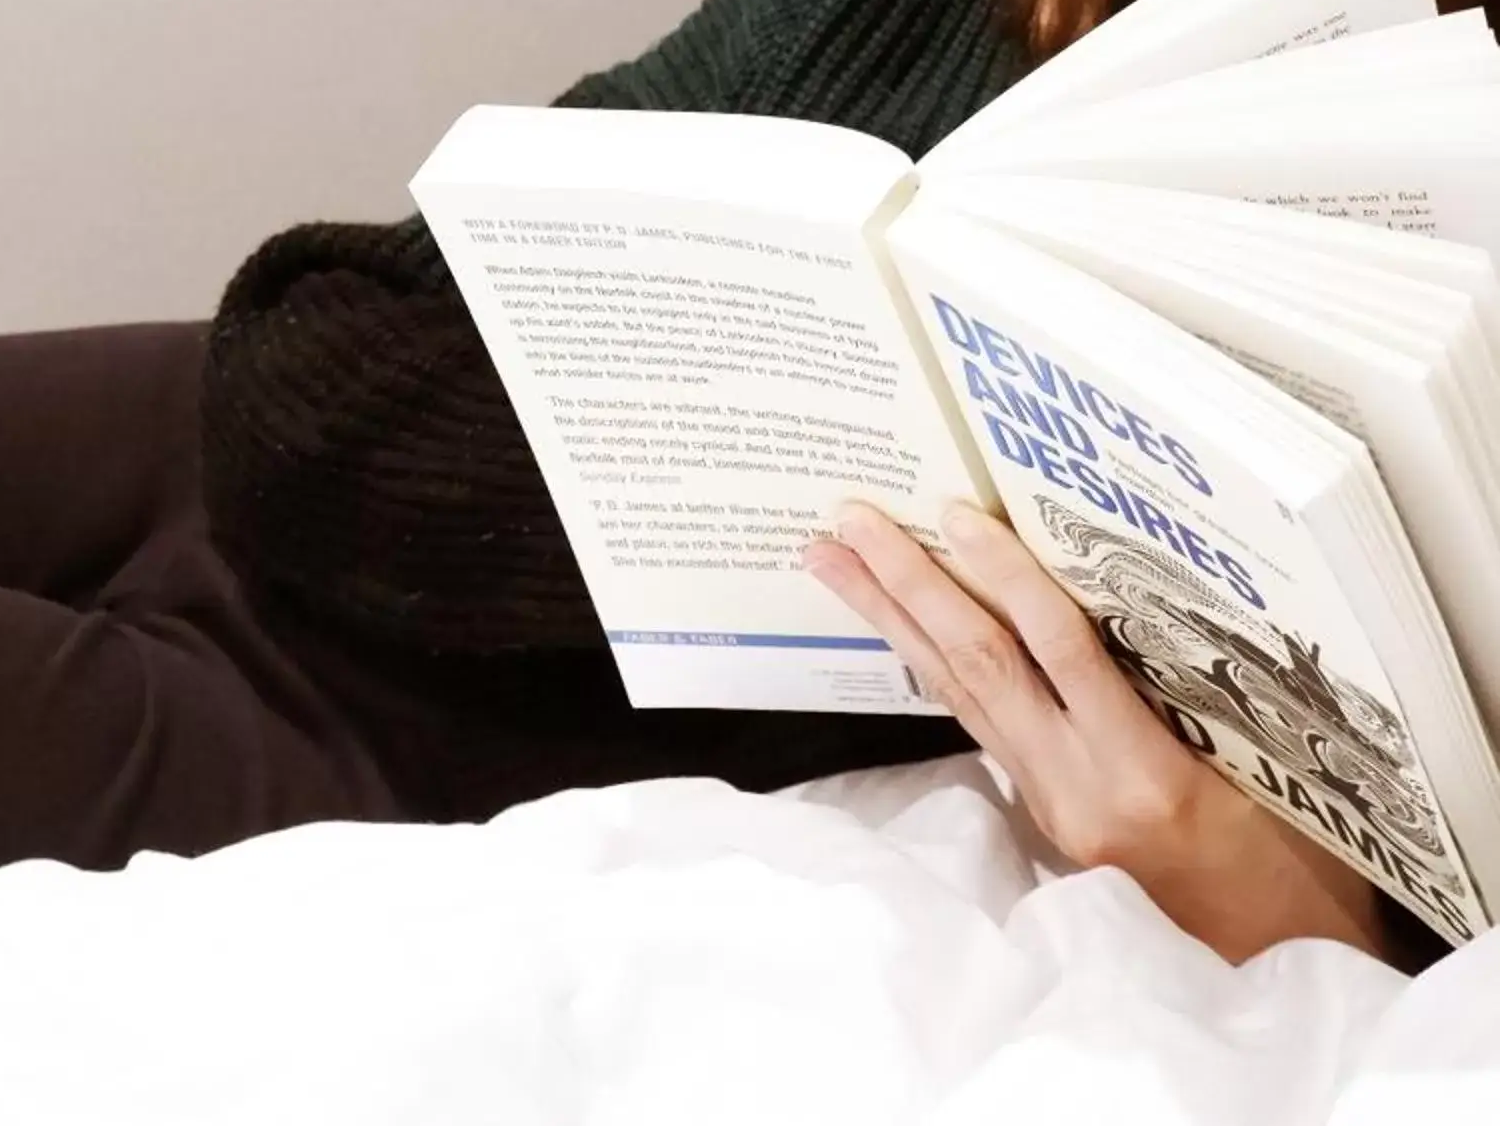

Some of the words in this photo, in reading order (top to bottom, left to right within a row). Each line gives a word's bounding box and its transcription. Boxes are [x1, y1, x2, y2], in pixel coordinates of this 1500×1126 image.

[683, 230, 756, 252] PUBLISHED
[577, 397, 648, 412] characters
[649, 401, 672, 413] are
[727, 405, 751, 419] the
[752, 409, 802, 424] writing
[929, 292, 1213, 498] DEVICES
[962, 357, 1099, 462] AND
[553, 414, 576, 426] the
[578, 415, 659, 431] descriptions
[661, 418, 675, 430] of
[677, 419, 699, 432] the
[745, 424, 770, 438] and
[771, 427, 841, 447] landscape
[898, 450, 922, 464] the
[651, 454, 665, 467] of
[785, 462, 810, 476] and
[982, 409, 1267, 611] DESIRES
[622, 631, 669, 645] FABER
[690, 633, 739, 647] FABER
[1251, 754, 1475, 942] JAMES
